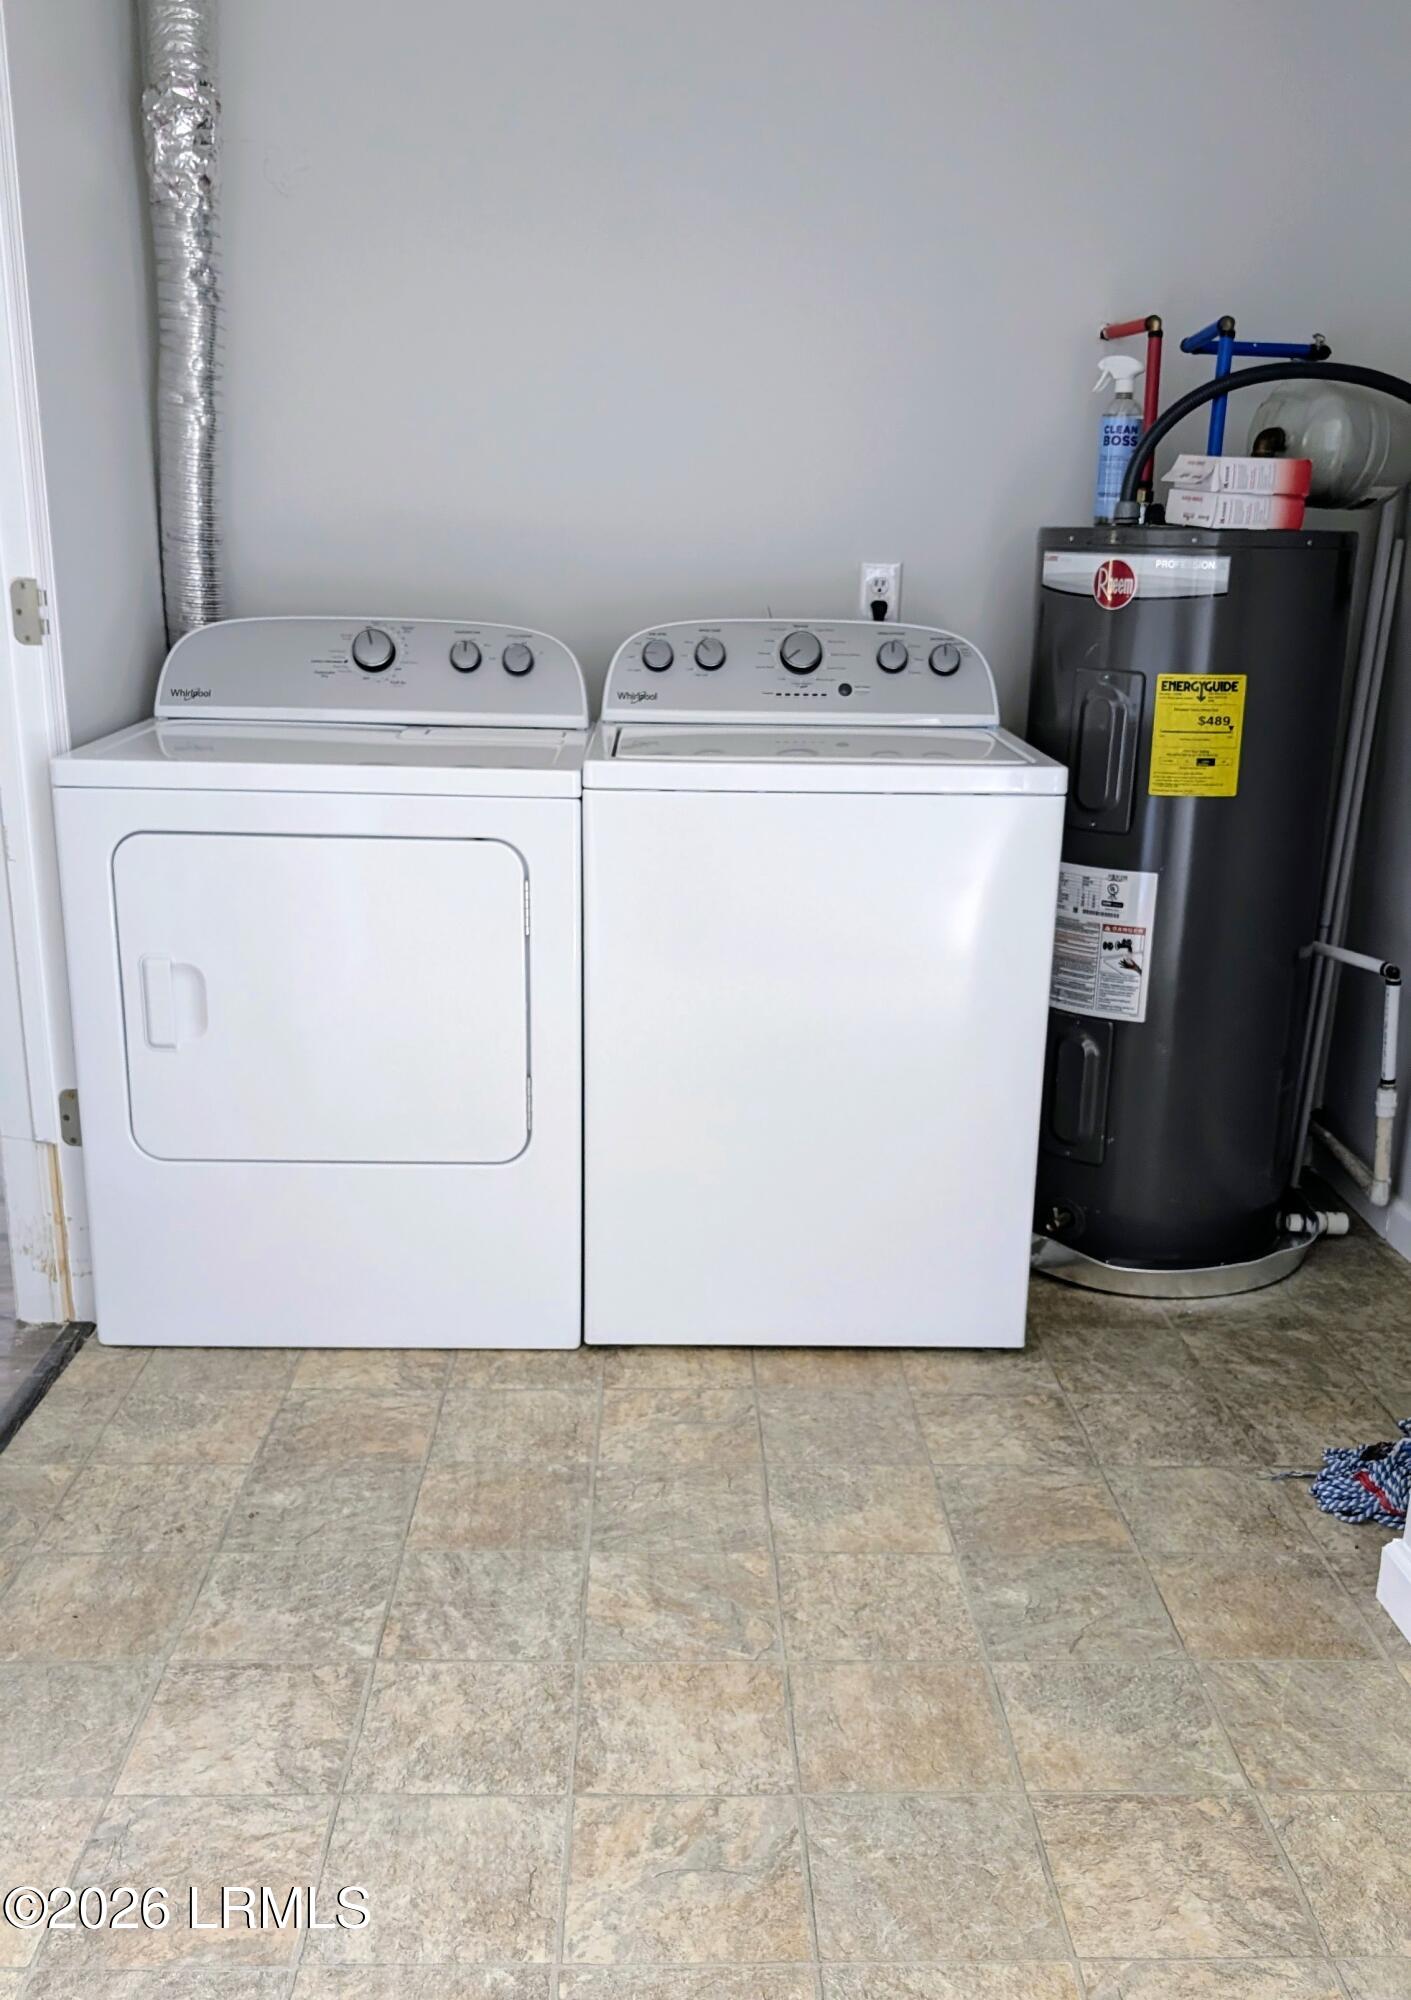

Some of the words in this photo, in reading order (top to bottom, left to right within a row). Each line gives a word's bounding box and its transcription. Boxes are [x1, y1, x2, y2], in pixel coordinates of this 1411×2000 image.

[1104, 425, 1138, 434] CLEAN
[1103, 435, 1138, 447] BOSS
[1097, 562, 1134, 601] Rheem
[170, 687, 212, 701] Whirlpool
[617, 690, 658, 704] Whirlpool
